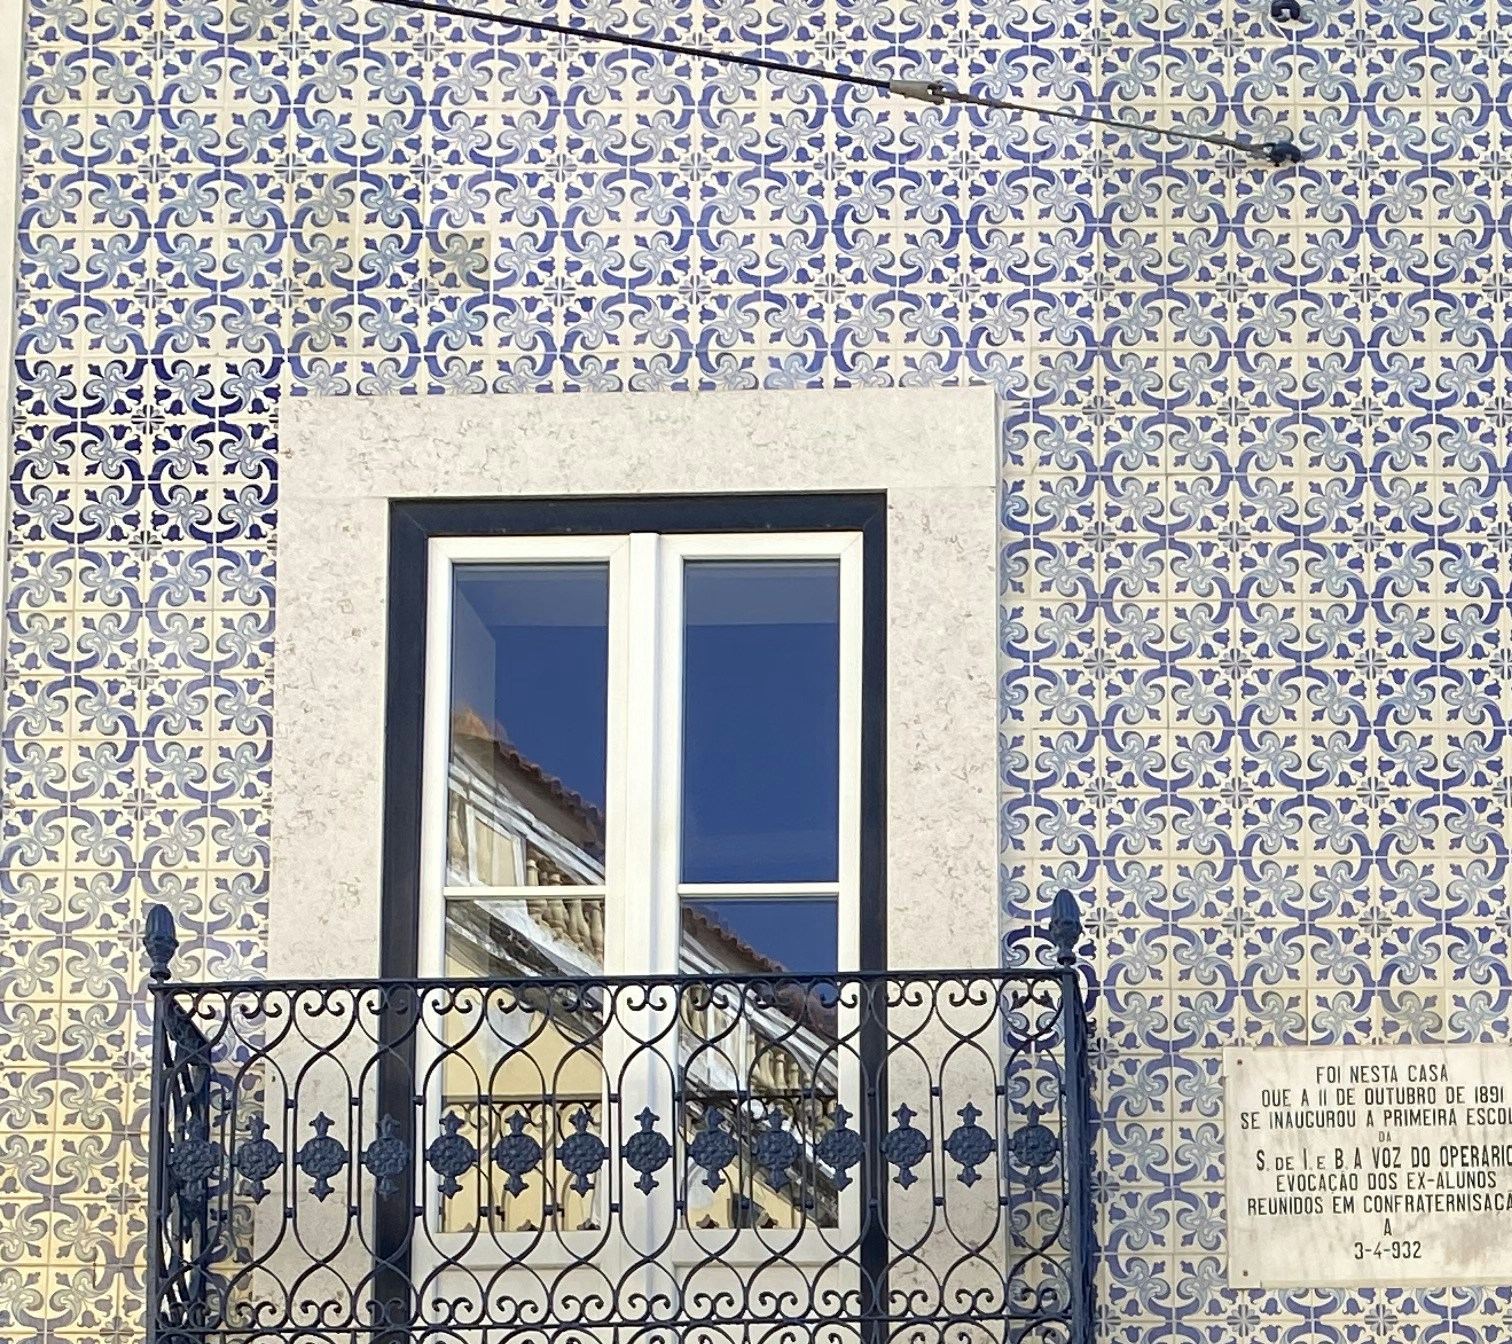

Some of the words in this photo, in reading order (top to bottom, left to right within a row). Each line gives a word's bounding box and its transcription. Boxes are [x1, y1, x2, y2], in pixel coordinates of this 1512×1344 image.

[1316, 1066, 1341, 1084] FOI
[1349, 1065, 1398, 1083] NESTA
[1408, 1064, 1448, 1082] CASA
[1300, 1088, 1310, 1107] A
[1336, 1088, 1355, 1106] DE
[1365, 1087, 1436, 1105] OUTUBRO
[1446, 1086, 1465, 1104] DE
[1475, 1085, 1504, 1103] 1891
[1241, 1111, 1260, 1130] SE
[1269, 1110, 1356, 1129] INAUGUROU
[1366, 1109, 1374, 1128] A
[1384, 1108, 1457, 1127] PRIMEIRA
[1379, 1131, 1392, 1142] DA
[1354, 1147, 1362, 1170] A
[1372, 1147, 1401, 1169] VOZ
[1411, 1146, 1430, 1168] DO
[1368, 1172, 1398, 1190] DOS
[1407, 1171, 1497, 1190] EX-ALUNOS
[1247, 1196, 1324, 1215] REUNIDOS
[1332, 1196, 1355, 1214] EM
[1384, 1218, 1392, 1236] A
[1354, 1240, 1421, 1260] 3-4-932
